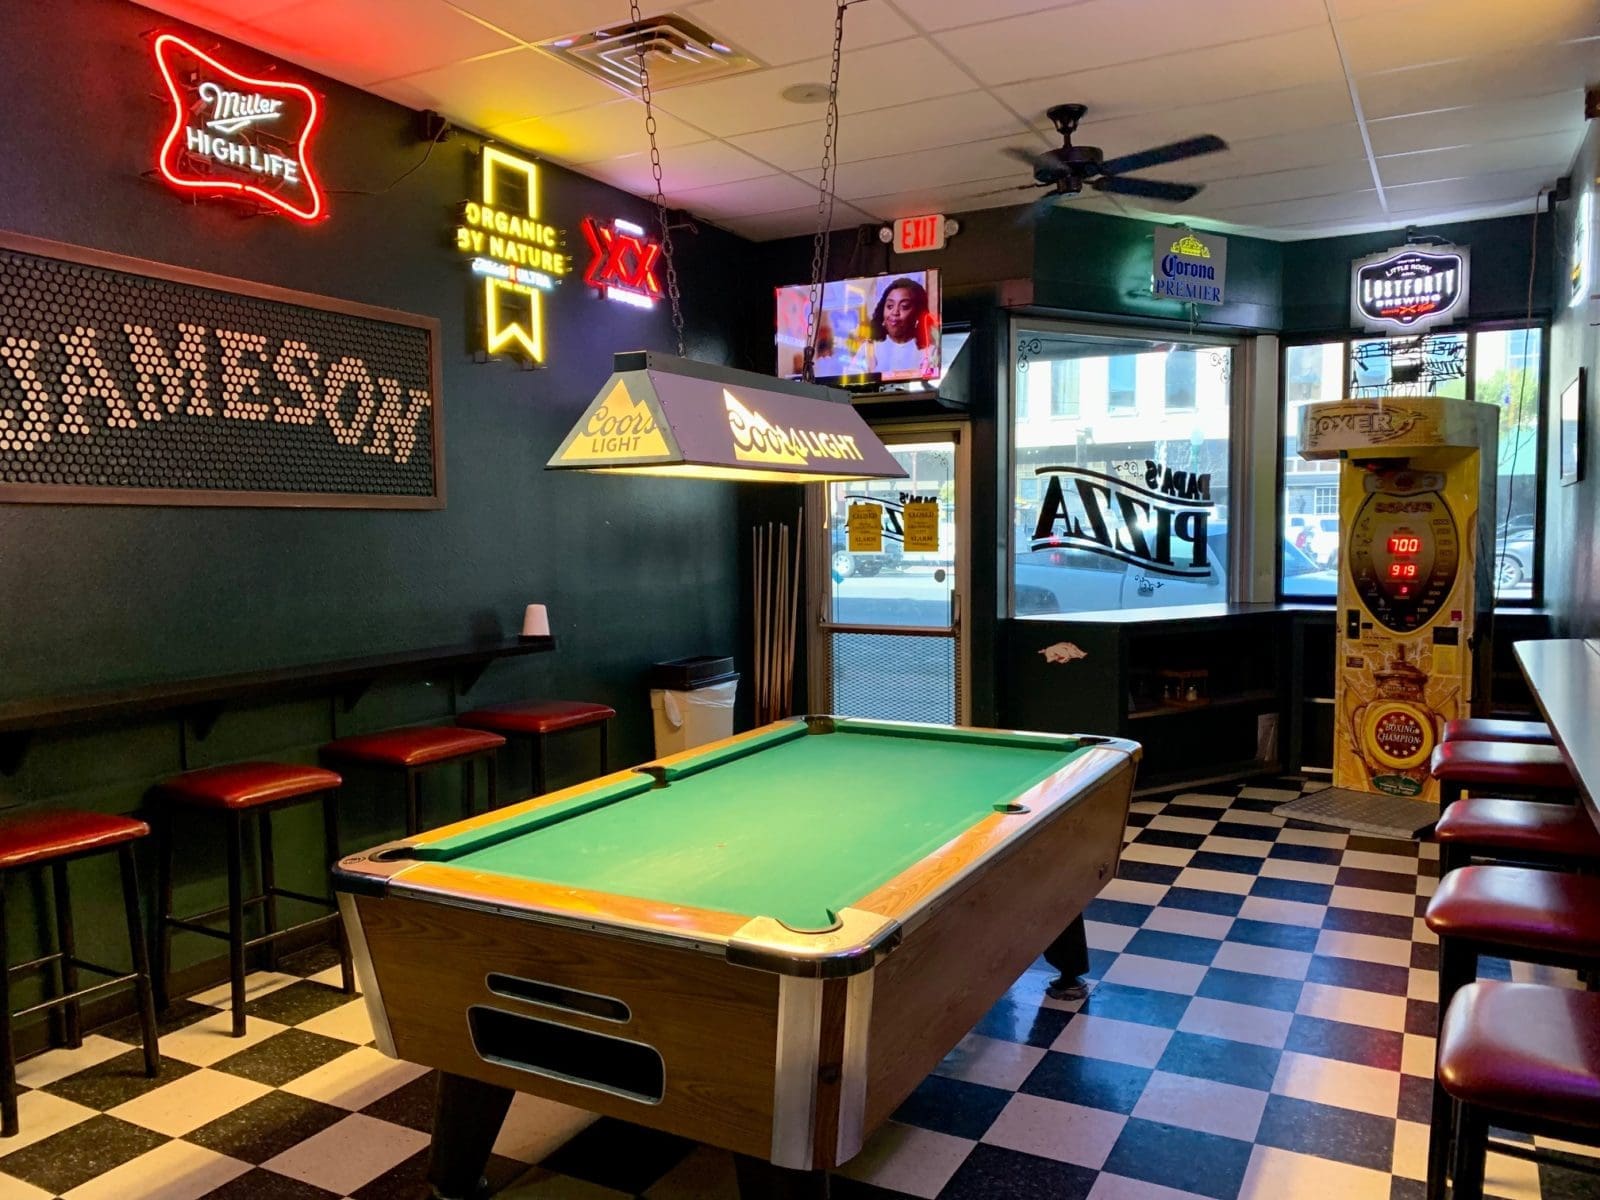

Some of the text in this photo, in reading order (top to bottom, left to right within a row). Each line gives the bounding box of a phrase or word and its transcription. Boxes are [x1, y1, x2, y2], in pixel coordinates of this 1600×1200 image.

[198, 82, 283, 119] Miller
[186, 126, 299, 183] HIGH LIFE
[464, 202, 556, 248] ORGANIC
[901, 217, 939, 249] EXIT
[456, 226, 484, 253] BY
[489, 234, 566, 275] NATURE
[1161, 254, 1215, 280] Corona
[1156, 279, 1221, 302] PREMIER
[1376, 294, 1442, 308] BREWING
[0, 325, 431, 464] JAMESON
[583, 405, 657, 437] Coors
[728, 409, 864, 461] Coors LIGHT
[592, 436, 640, 454] LIGHT
[1391, 538, 1419, 553] 700
[1377, 731, 1421, 744] CHAMPION
[1384, 722, 1416, 734] BOXING
